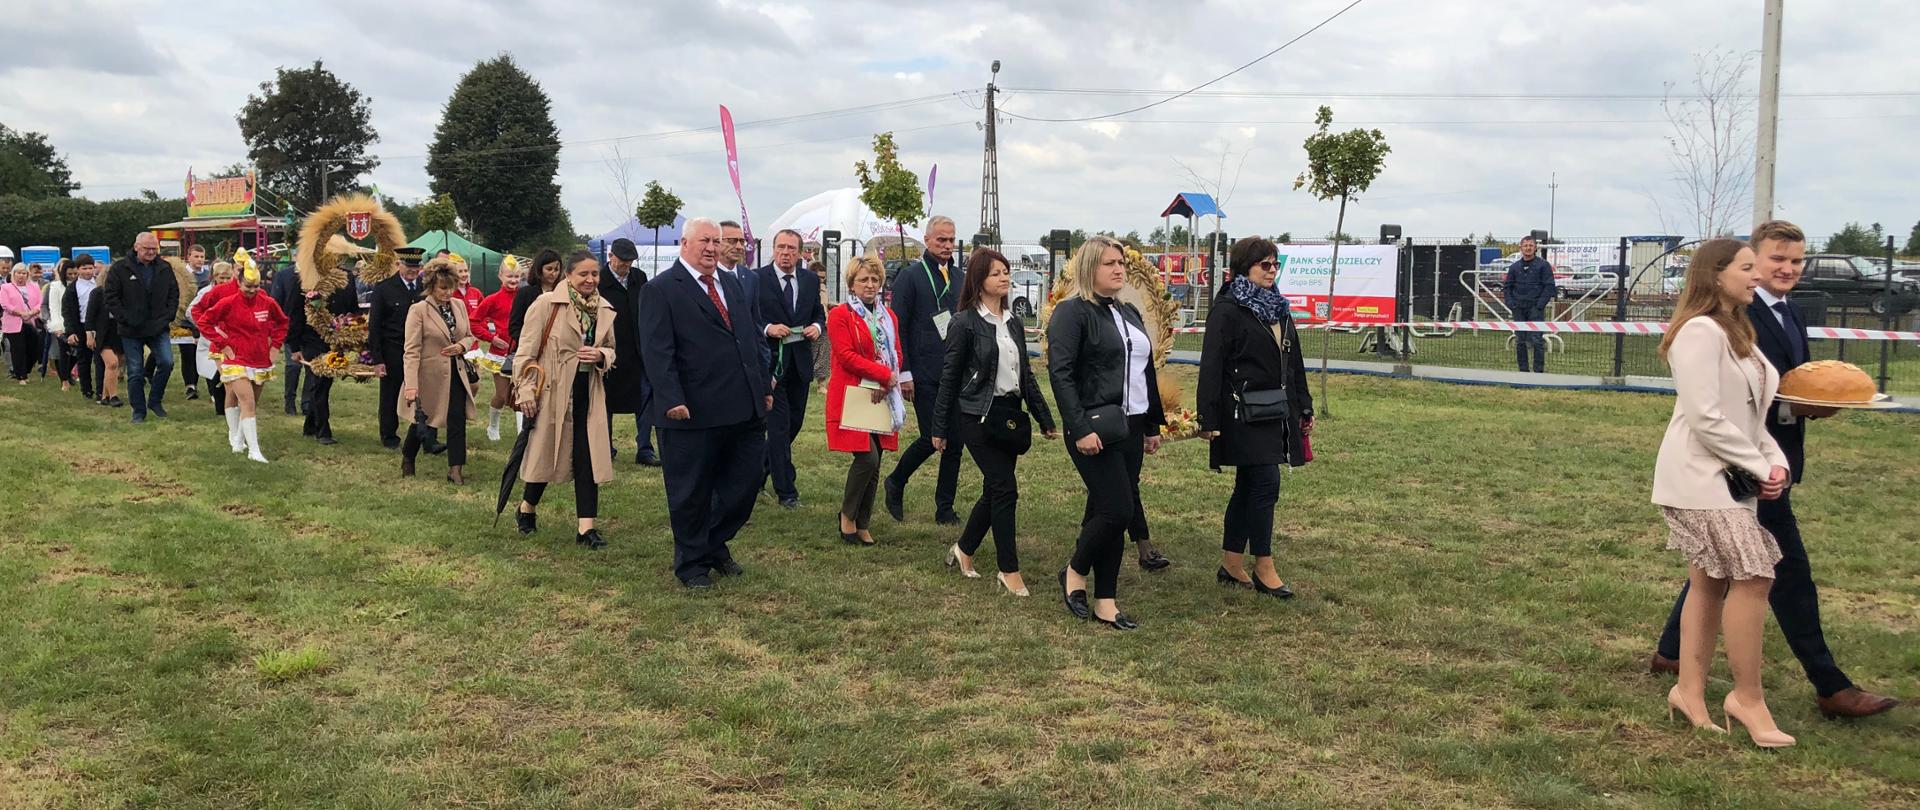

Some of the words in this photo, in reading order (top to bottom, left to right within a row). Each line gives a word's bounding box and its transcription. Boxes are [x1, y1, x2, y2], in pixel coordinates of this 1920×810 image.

[1290, 256, 1313, 265] BANK
[1316, 255, 1382, 265] SPÓDZIELCZY
[1289, 267, 1298, 275] W
[1289, 279, 1308, 287] Grupa
